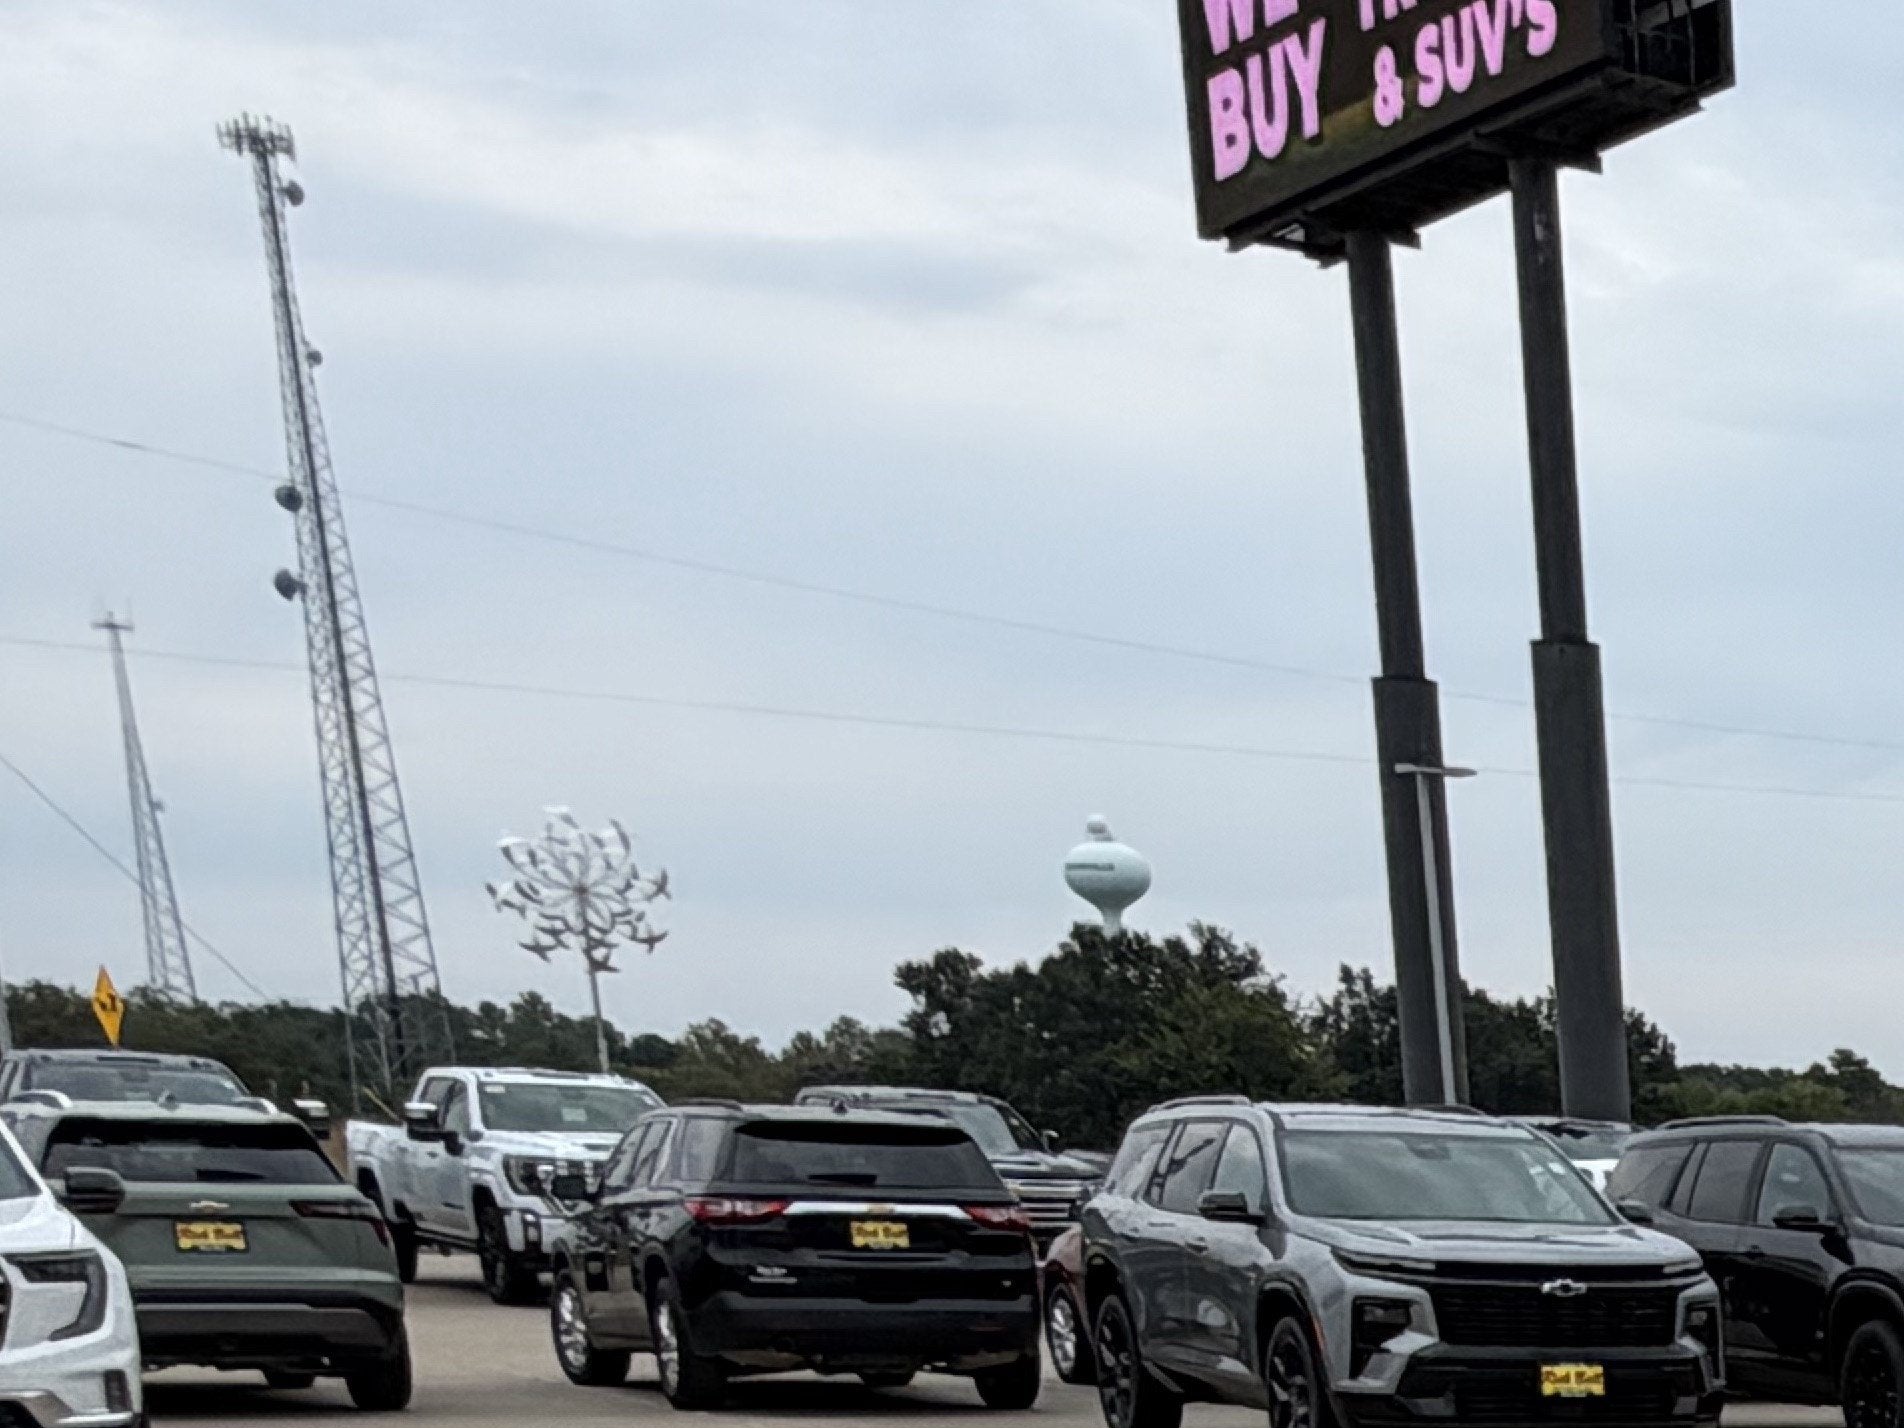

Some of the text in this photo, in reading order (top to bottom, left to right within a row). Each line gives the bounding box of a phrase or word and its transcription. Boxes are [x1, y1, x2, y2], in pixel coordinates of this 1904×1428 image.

[1206, 17, 1327, 182] BUY
[1372, 0, 1558, 128] & SUV'S
